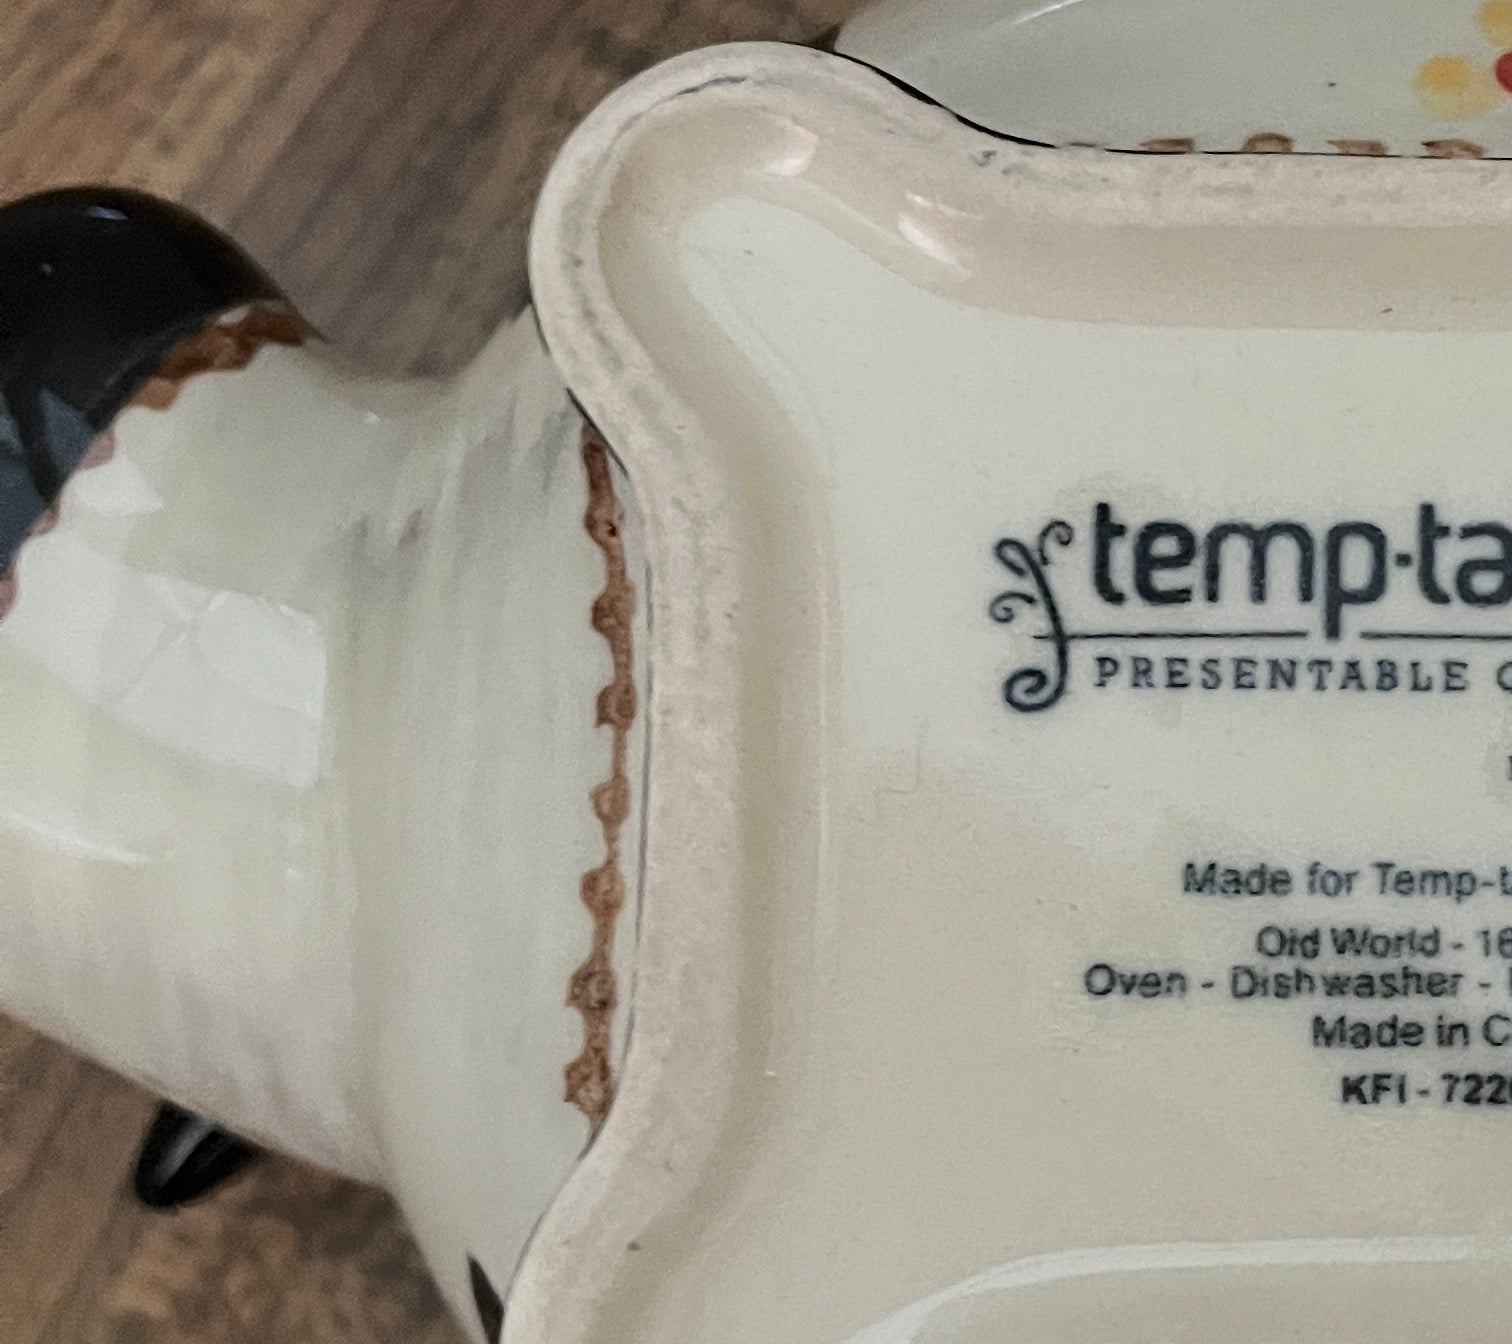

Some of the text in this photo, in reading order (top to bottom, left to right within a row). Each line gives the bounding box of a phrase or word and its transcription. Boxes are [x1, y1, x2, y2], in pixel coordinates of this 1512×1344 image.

[1092, 655, 1470, 694] PRESENTABLE
[1183, 862, 1293, 895] Made
[1308, 862, 1358, 896] for
[1257, 926, 1319, 958] Old
[1331, 924, 1442, 960] World
[1084, 962, 1189, 1000] Oven
[1230, 964, 1463, 1000] Dishwasher
[1311, 1013, 1424, 1050] Made
[1435, 1013, 1471, 1050] in
[1341, 1072, 1406, 1106] KFI
